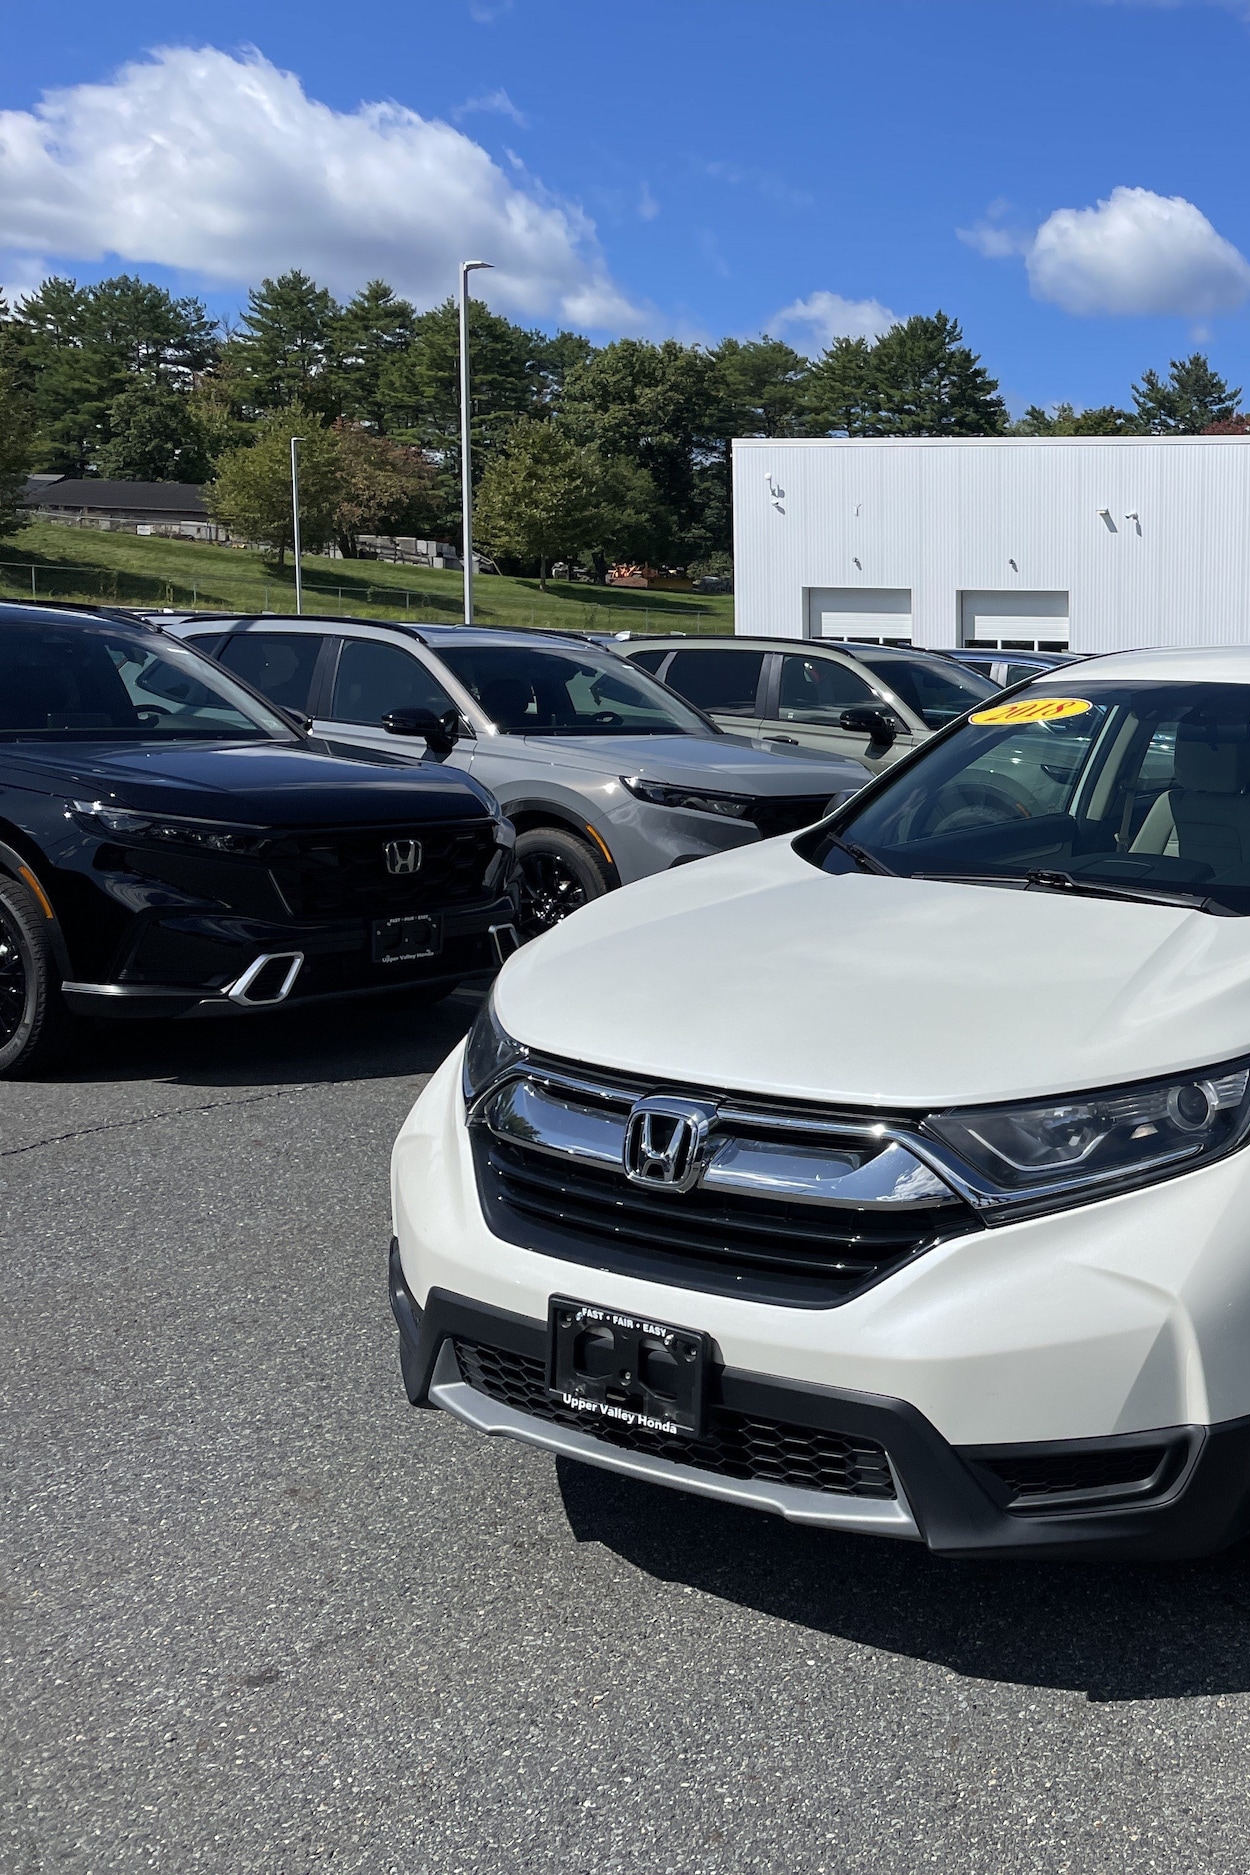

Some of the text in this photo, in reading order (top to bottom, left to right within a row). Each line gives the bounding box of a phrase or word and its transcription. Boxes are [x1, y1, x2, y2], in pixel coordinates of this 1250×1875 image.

[983, 701, 1076, 722] 2018
[581, 1308, 667, 1338] FAST FAIR EASY
[562, 1392, 678, 1435] Upper Valley Honda
